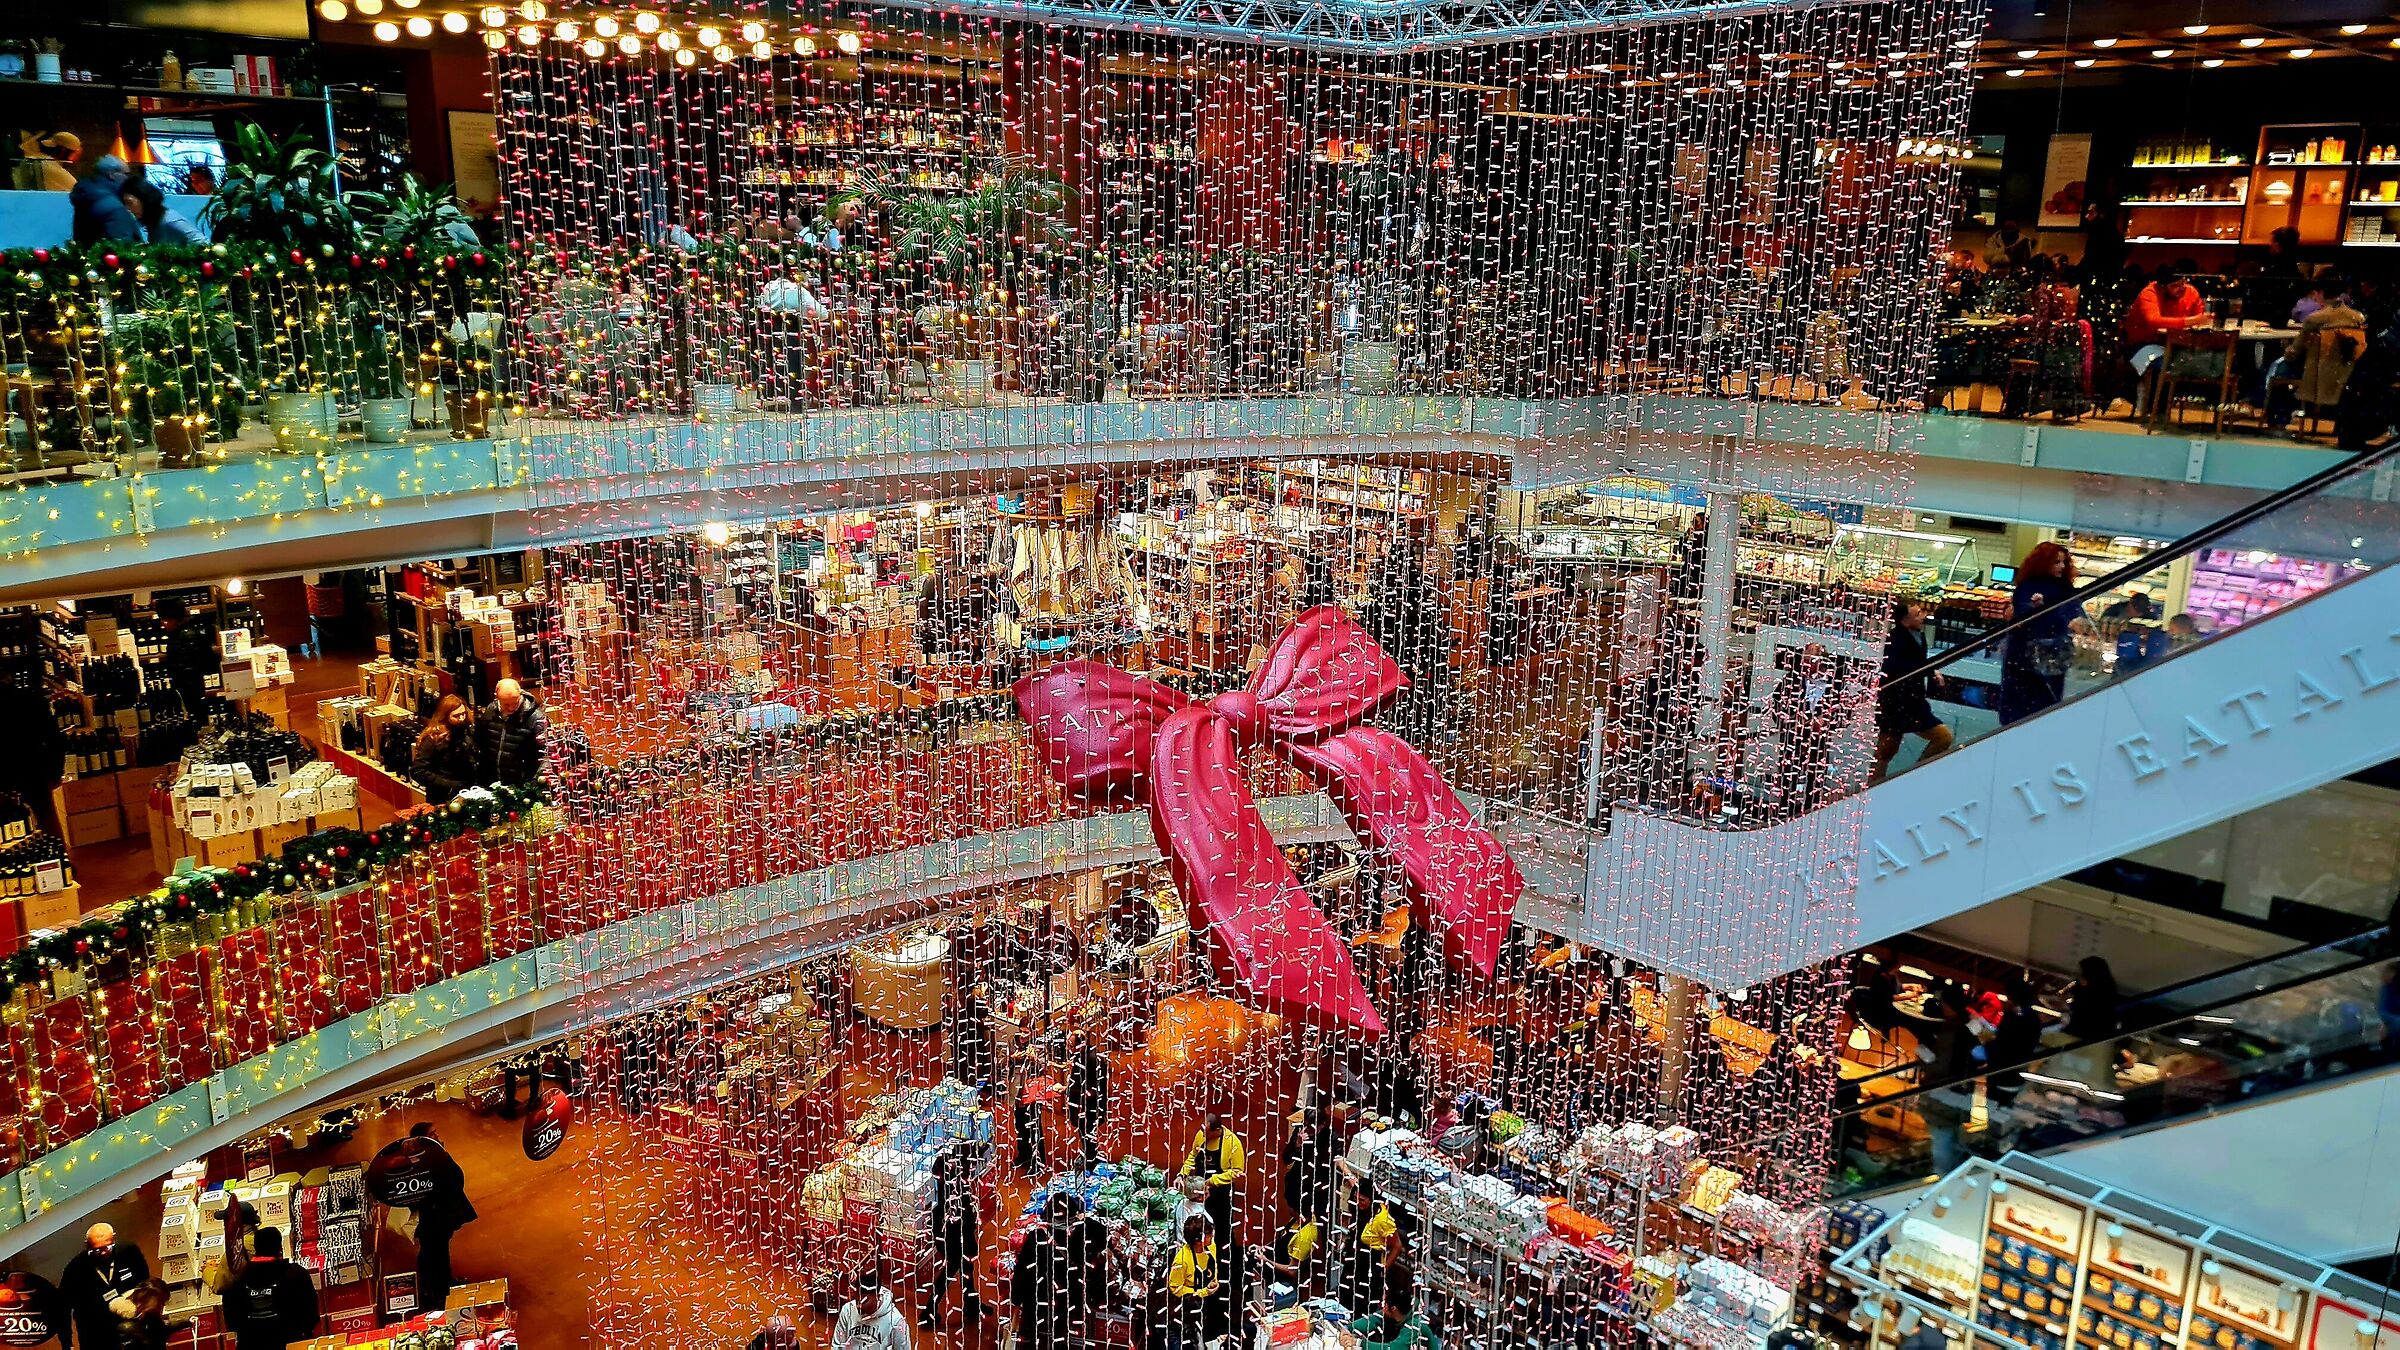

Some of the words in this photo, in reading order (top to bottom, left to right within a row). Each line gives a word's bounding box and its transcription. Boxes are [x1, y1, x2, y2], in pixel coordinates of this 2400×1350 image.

[2012, 760, 2087, 822] IS
[2116, 628, 2400, 782] EATAL
[388, 1178, 434, 1195] -20%
[0, 1316, 48, 1333] -20%
